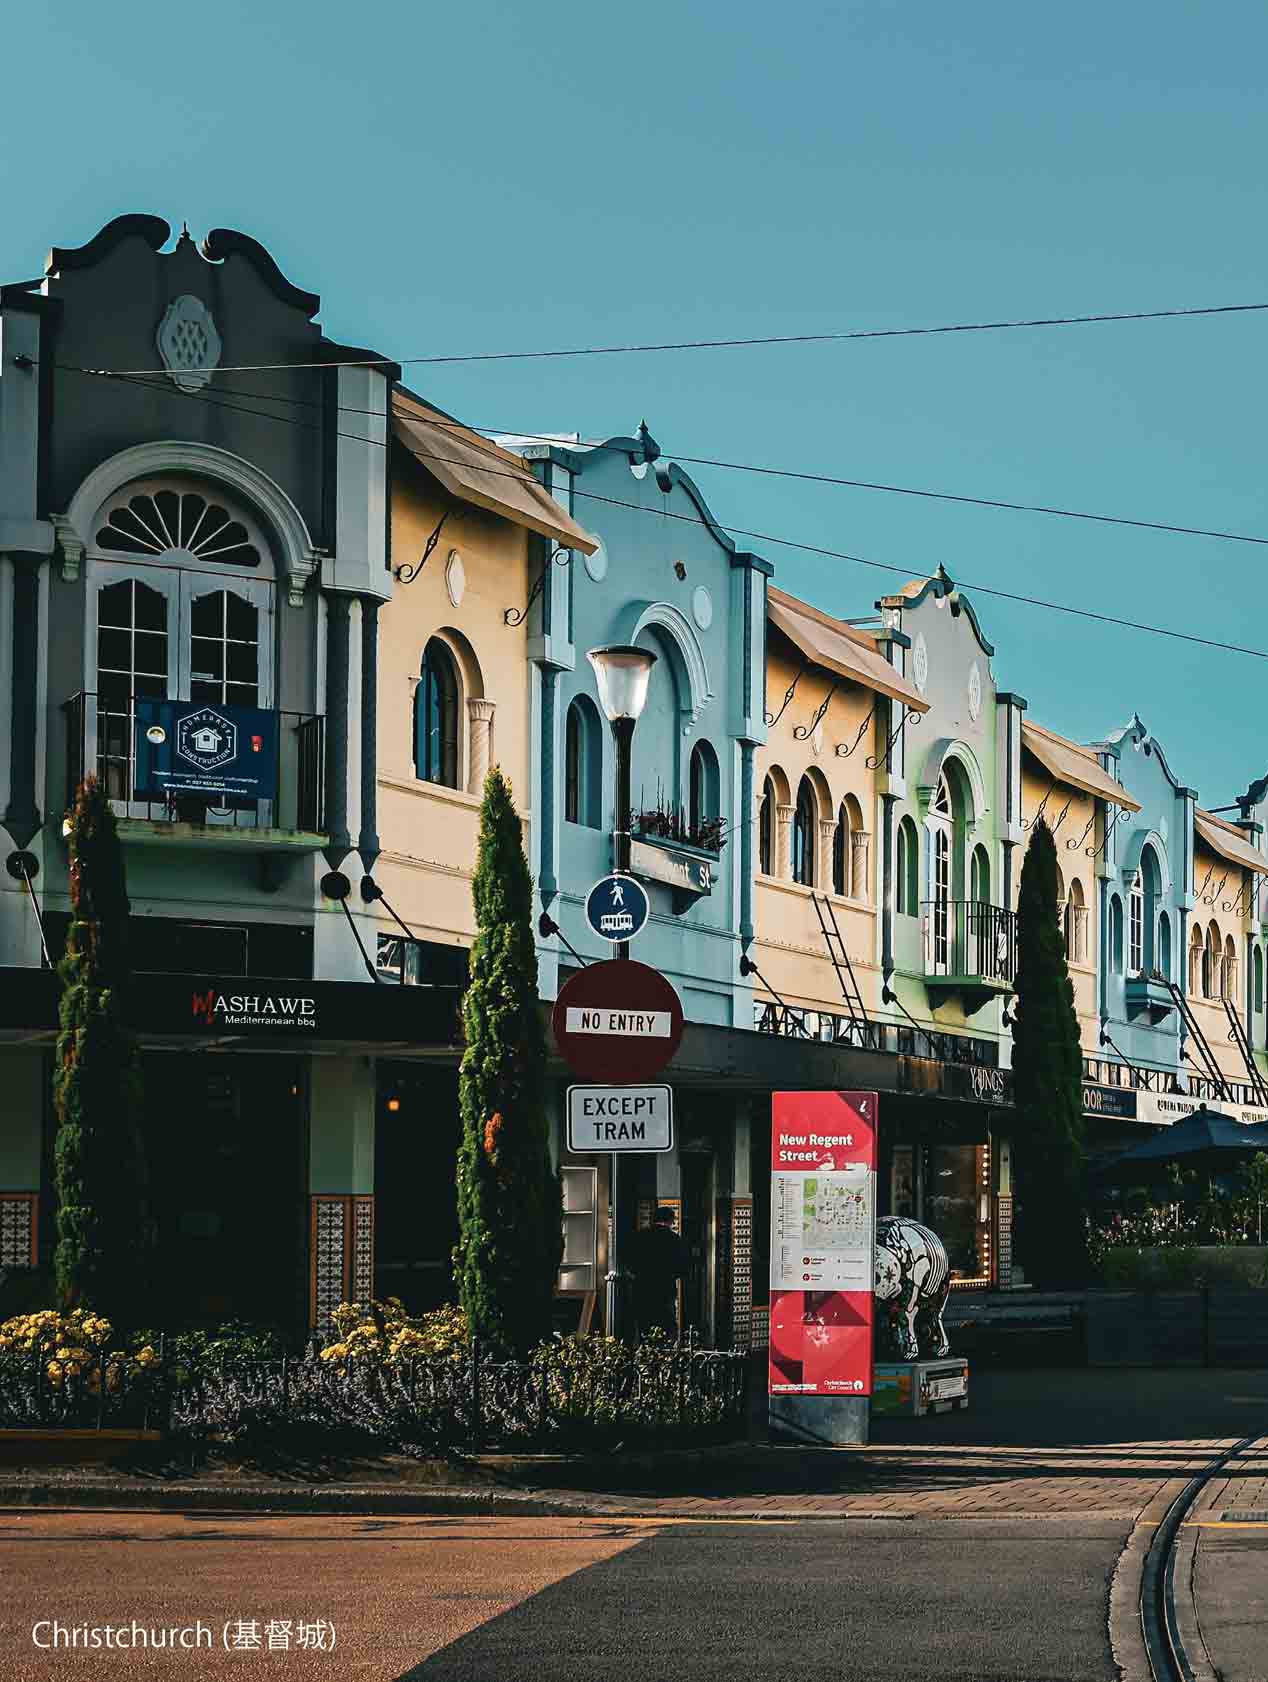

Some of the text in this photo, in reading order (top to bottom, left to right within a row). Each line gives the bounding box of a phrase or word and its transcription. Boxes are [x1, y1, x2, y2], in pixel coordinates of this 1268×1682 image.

[180, 744, 231, 765] CONSTRUCTION
[192, 990, 317, 1024] MASHAWE
[224, 1015, 316, 1028] Mediterranean bbq
[581, 1012, 656, 1032] NO ENTRY
[583, 1096, 657, 1116] EXCEPT
[1081, 1087, 1102, 1111] OOR
[593, 1121, 646, 1141] TRAM
[779, 1133, 853, 1148] New Regent
[779, 1150, 818, 1162] Street
